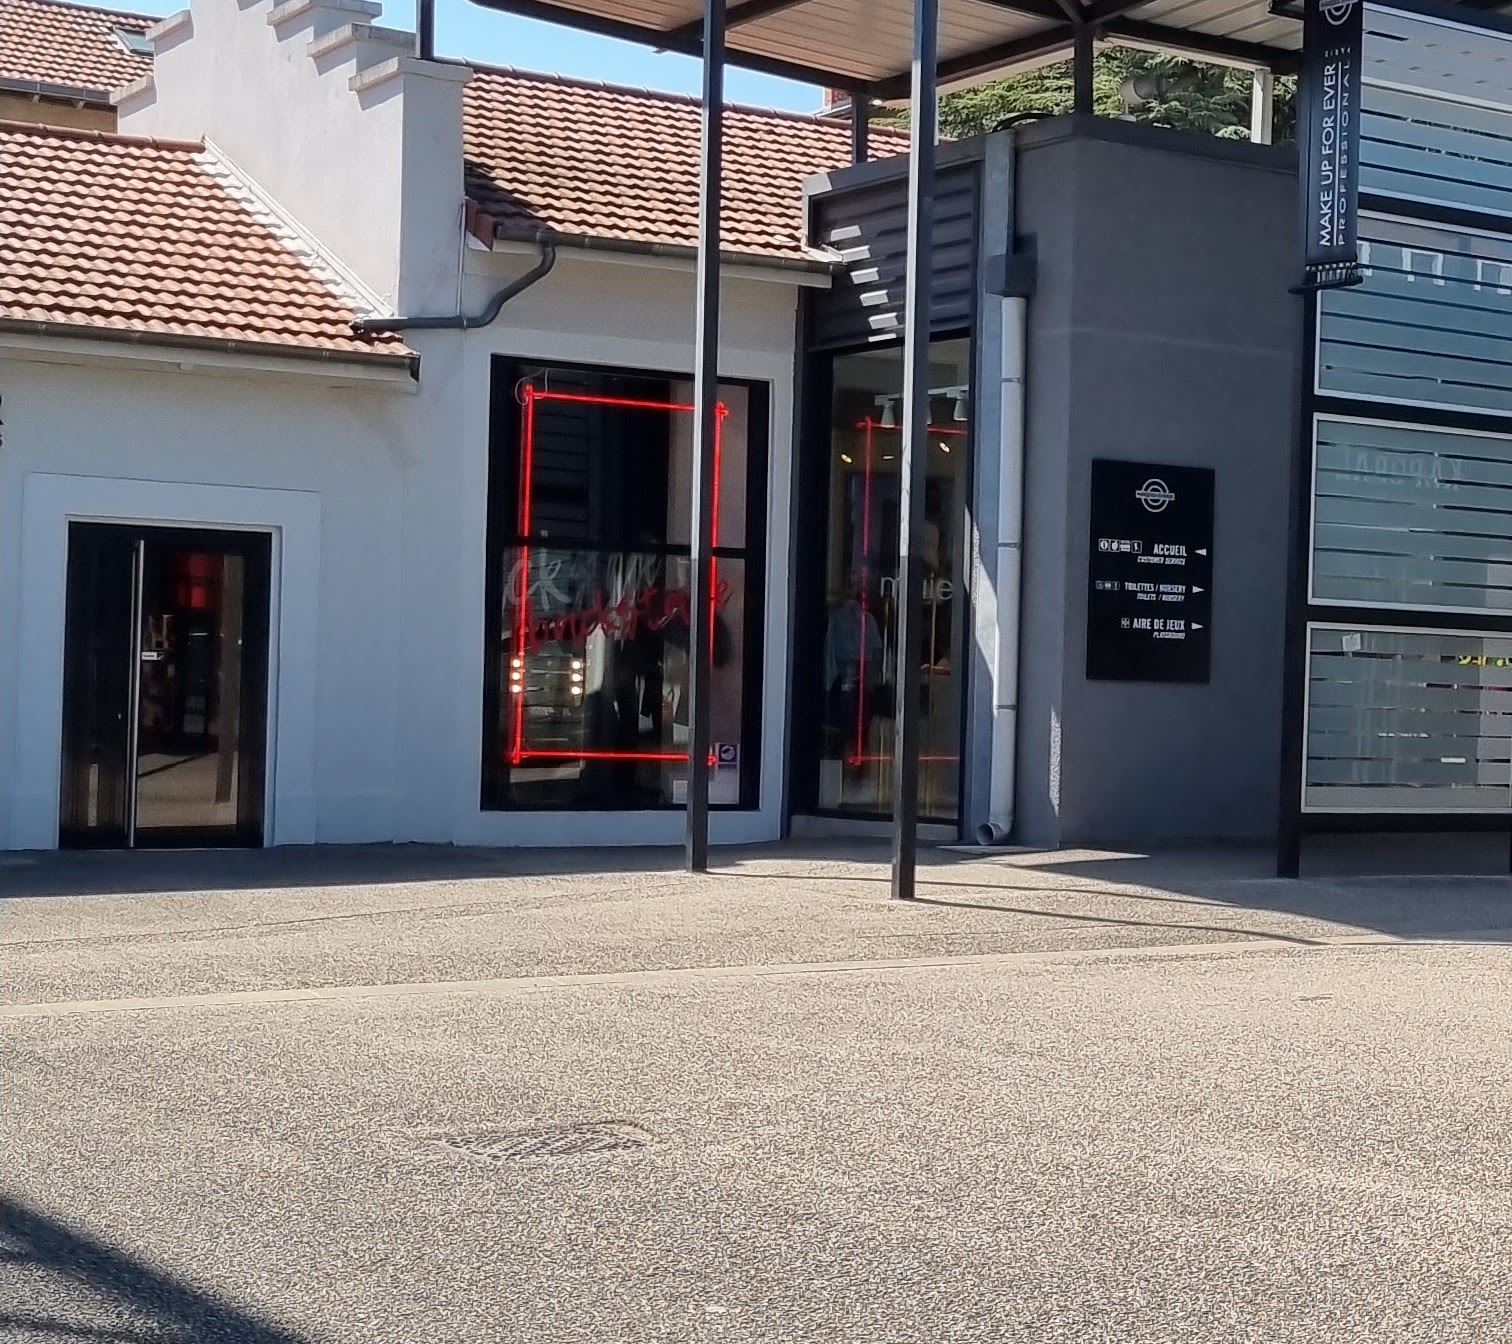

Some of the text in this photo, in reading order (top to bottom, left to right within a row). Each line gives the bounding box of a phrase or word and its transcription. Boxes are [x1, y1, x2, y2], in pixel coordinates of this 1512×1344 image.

[1319, 63, 1337, 246] MAKE UP FOR EVER
[1338, 60, 1351, 246] PROFESSIONAL
[1153, 544, 1187, 556] ACCUEIL
[1133, 618, 1186, 631] AIRE DE JEUX
